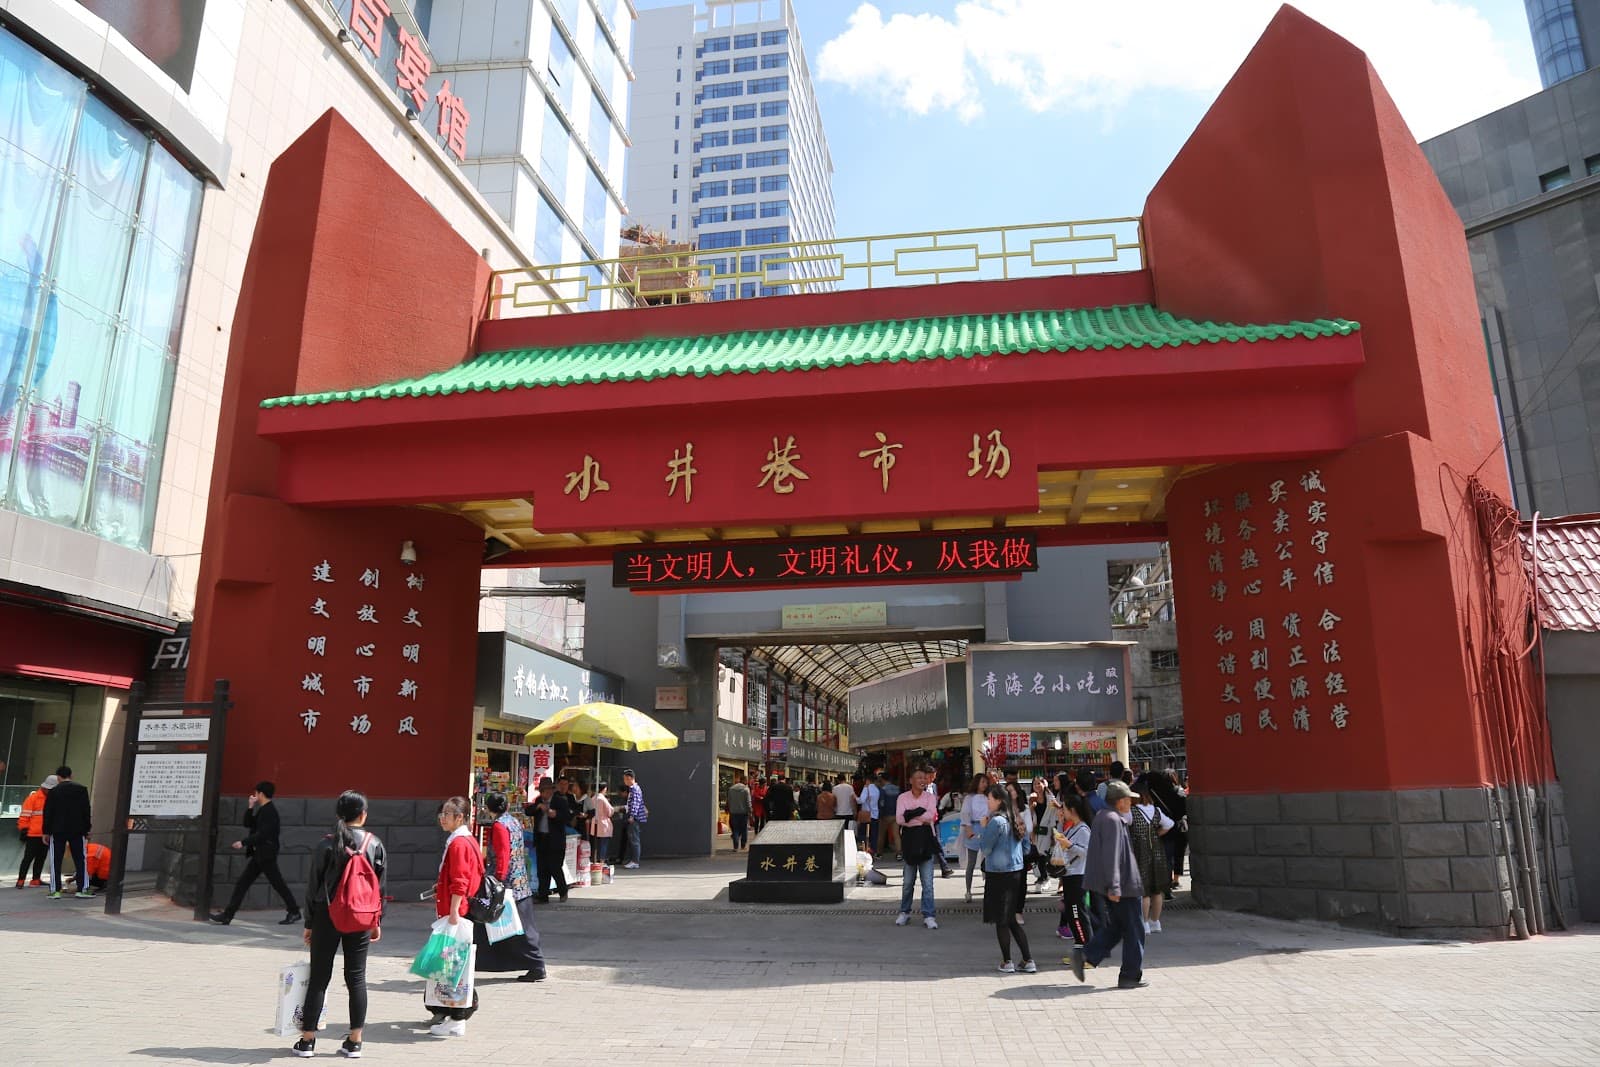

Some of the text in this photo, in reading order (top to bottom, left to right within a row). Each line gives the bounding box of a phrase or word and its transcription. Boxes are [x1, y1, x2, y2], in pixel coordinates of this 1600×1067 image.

[564, 429, 1011, 503] 水井巷市场
[300, 560, 335, 734] 建文明城市
[350, 568, 379, 734] 创放心市场
[398, 573, 425, 735] 树文明新风
[1214, 624, 1242, 735] 和谐文明
[1235, 492, 1277, 731] 服务热心 周到便民
[1268, 480, 1311, 731] 买卖公平 货正源清
[1300, 470, 1350, 729] 诚实守信 合法经营
[980, 671, 1101, 698] 青海名小吃
[1105, 667, 1119, 696] 酸奶
[760, 855, 820, 872] 水井巷
